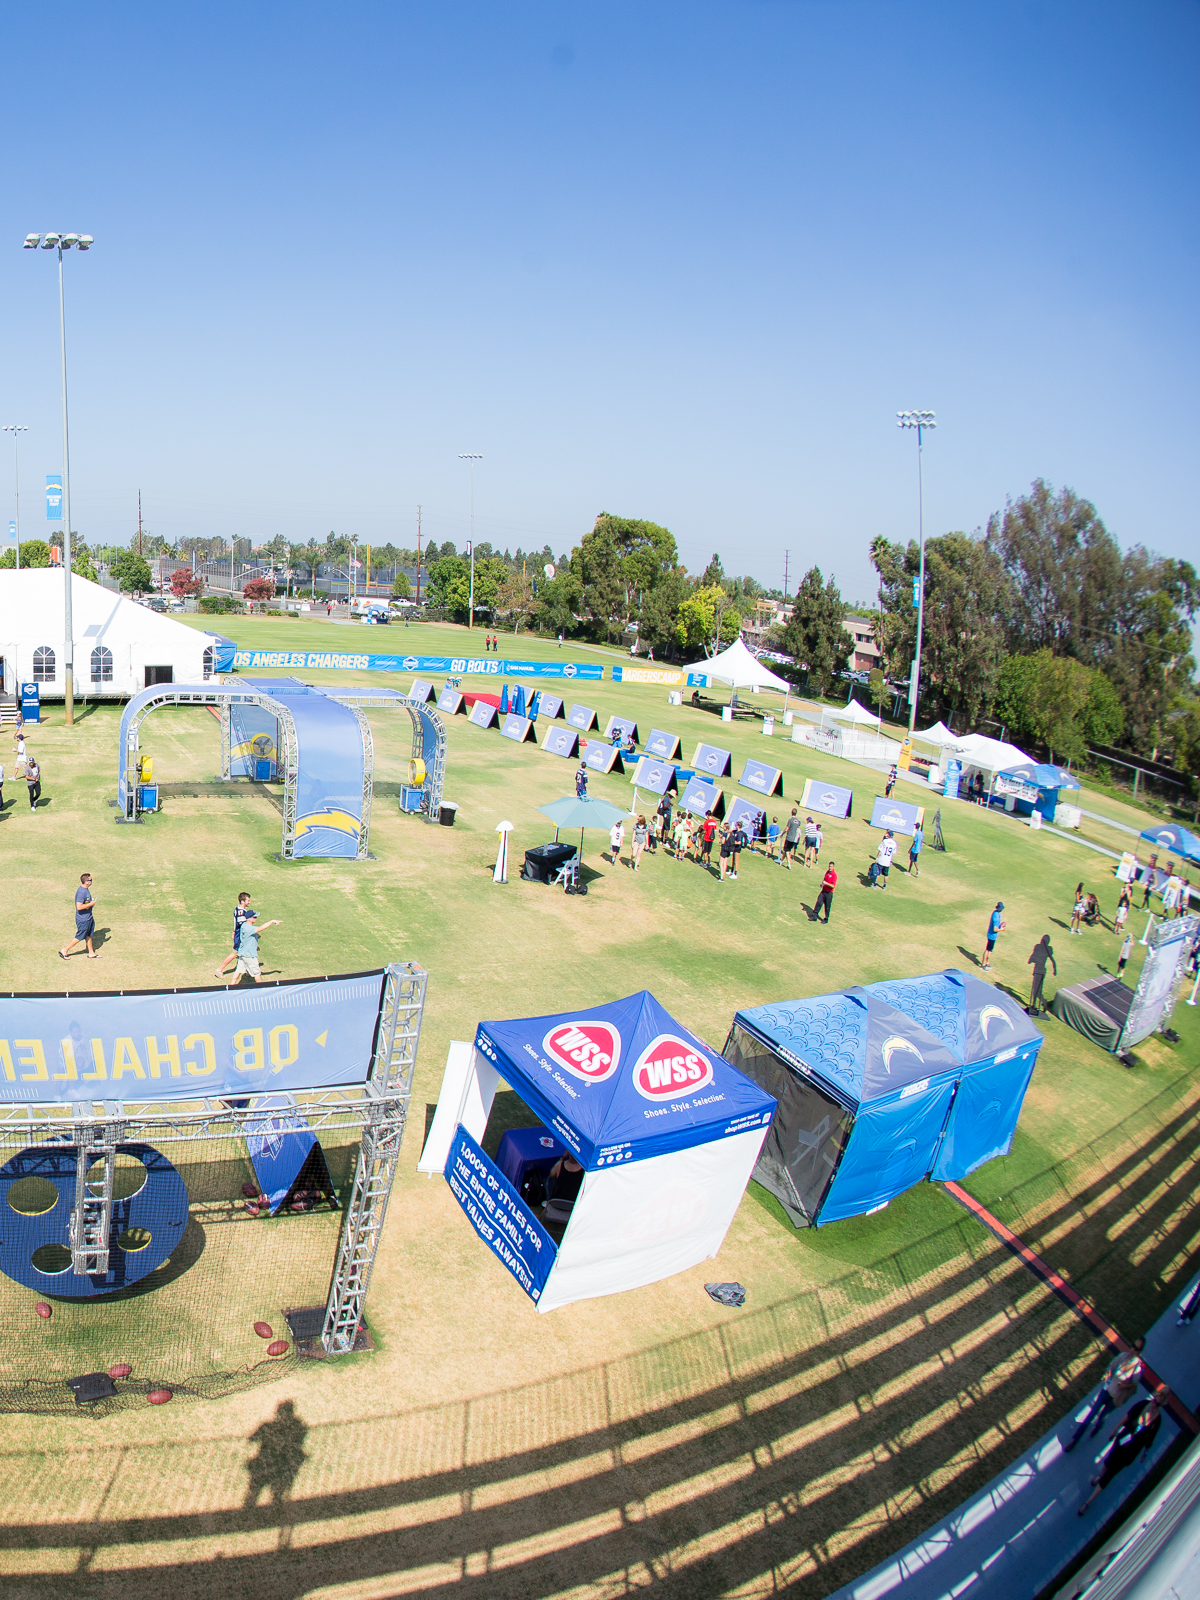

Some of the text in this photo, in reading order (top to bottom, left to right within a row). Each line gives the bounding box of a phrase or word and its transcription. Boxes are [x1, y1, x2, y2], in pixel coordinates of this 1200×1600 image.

[250, 652, 306, 667] ANGELES
[307, 654, 370, 669] CHARGERS
[450, 659, 499, 673] GO BOLTS
[622, 670, 680, 684] HARGERSCAMP
[522, 1043, 539, 1061] Shoes.
[538, 1058, 552, 1074] Style.
[554, 1026, 612, 1073] WSS
[641, 1055, 702, 1089] WSS
[644, 1108, 670, 1118] Shoes.
[671, 1102, 692, 1112] Style.
[724, 1119, 761, 1133] shopWSS.com
[552, 1118, 581, 1153] shopWSS.com
[455, 1156, 523, 1250] THE ENTIRE FAMILY.
[460, 1141, 542, 1252] 1,000'S OF STYLES FOR
[449, 1176, 533, 1291] BEST VALUES ALWAYS!!!
